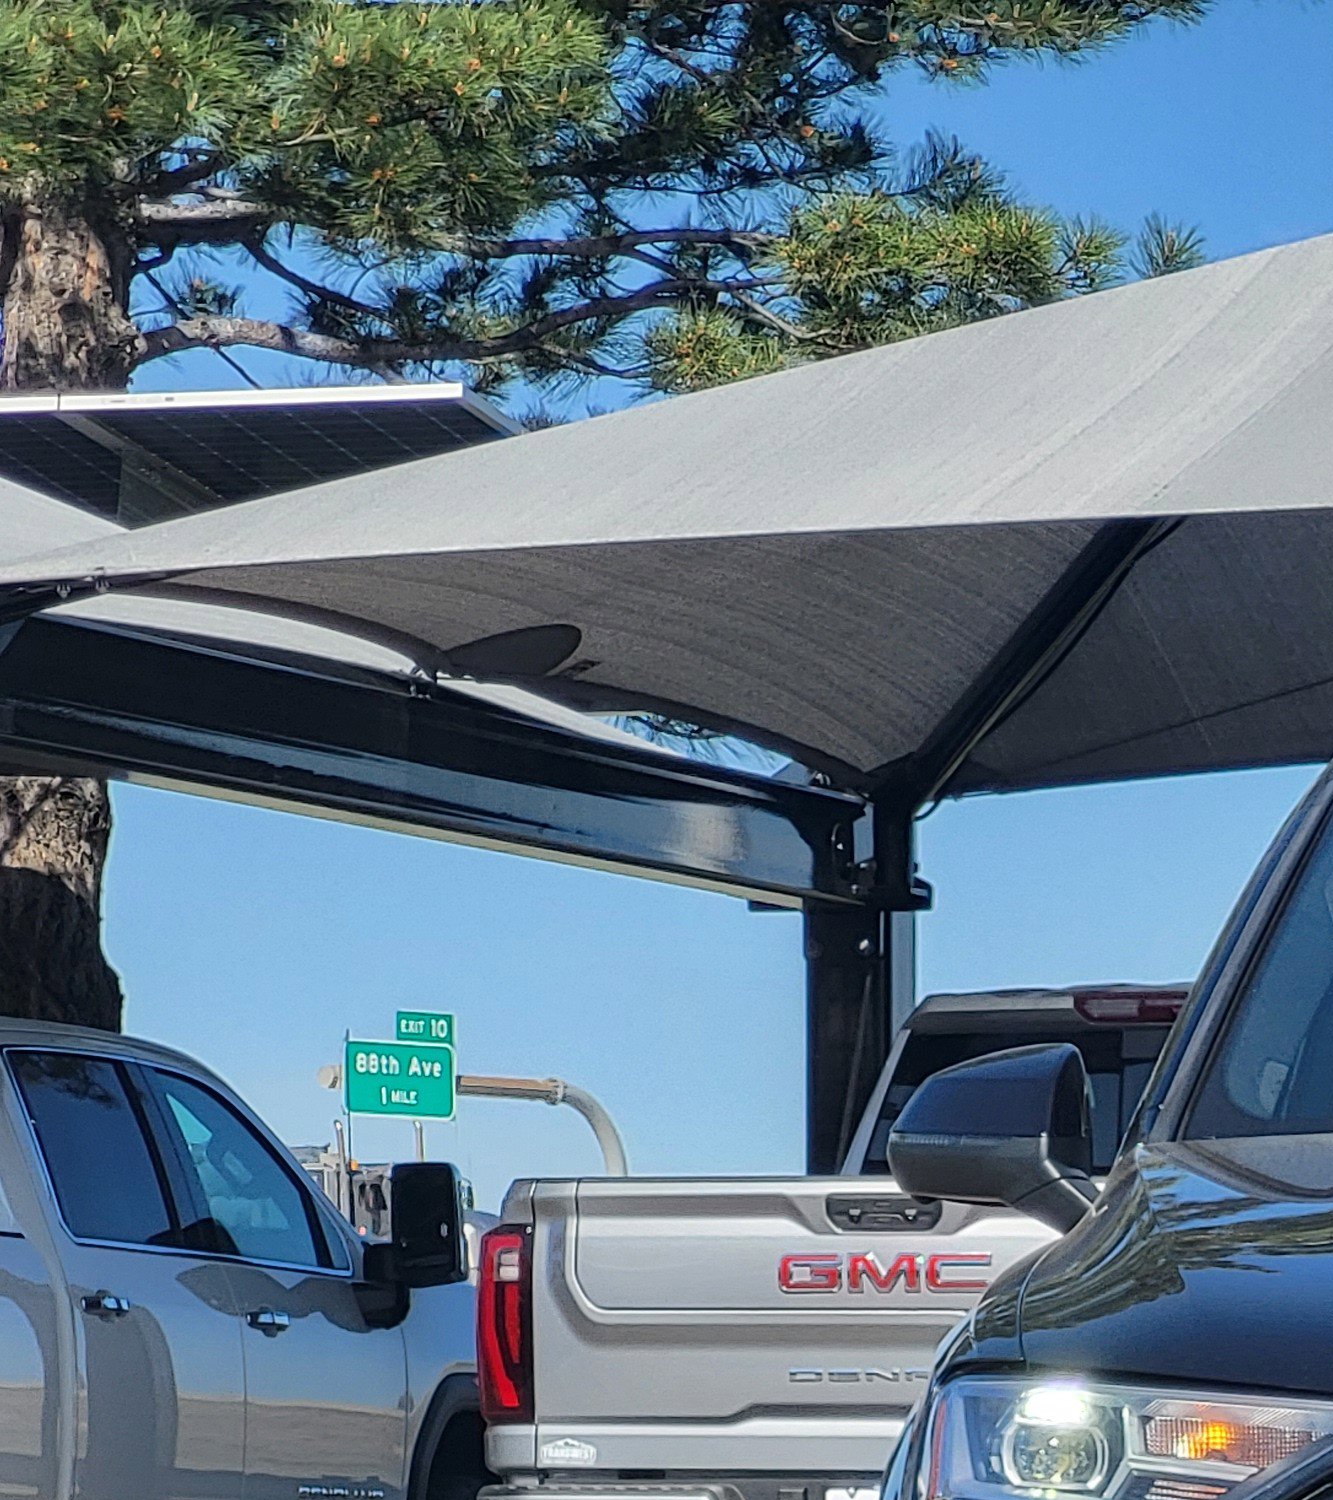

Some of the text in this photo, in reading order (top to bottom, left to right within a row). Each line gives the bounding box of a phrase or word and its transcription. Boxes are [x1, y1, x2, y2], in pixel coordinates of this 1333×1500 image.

[399, 1018, 448, 1038] EXIT 10
[355, 1052, 442, 1077] 88th Ave
[380, 1086, 417, 1105] 1 MILE
[778, 1251, 991, 1294] GMC
[788, 1367, 930, 1382] DENA
